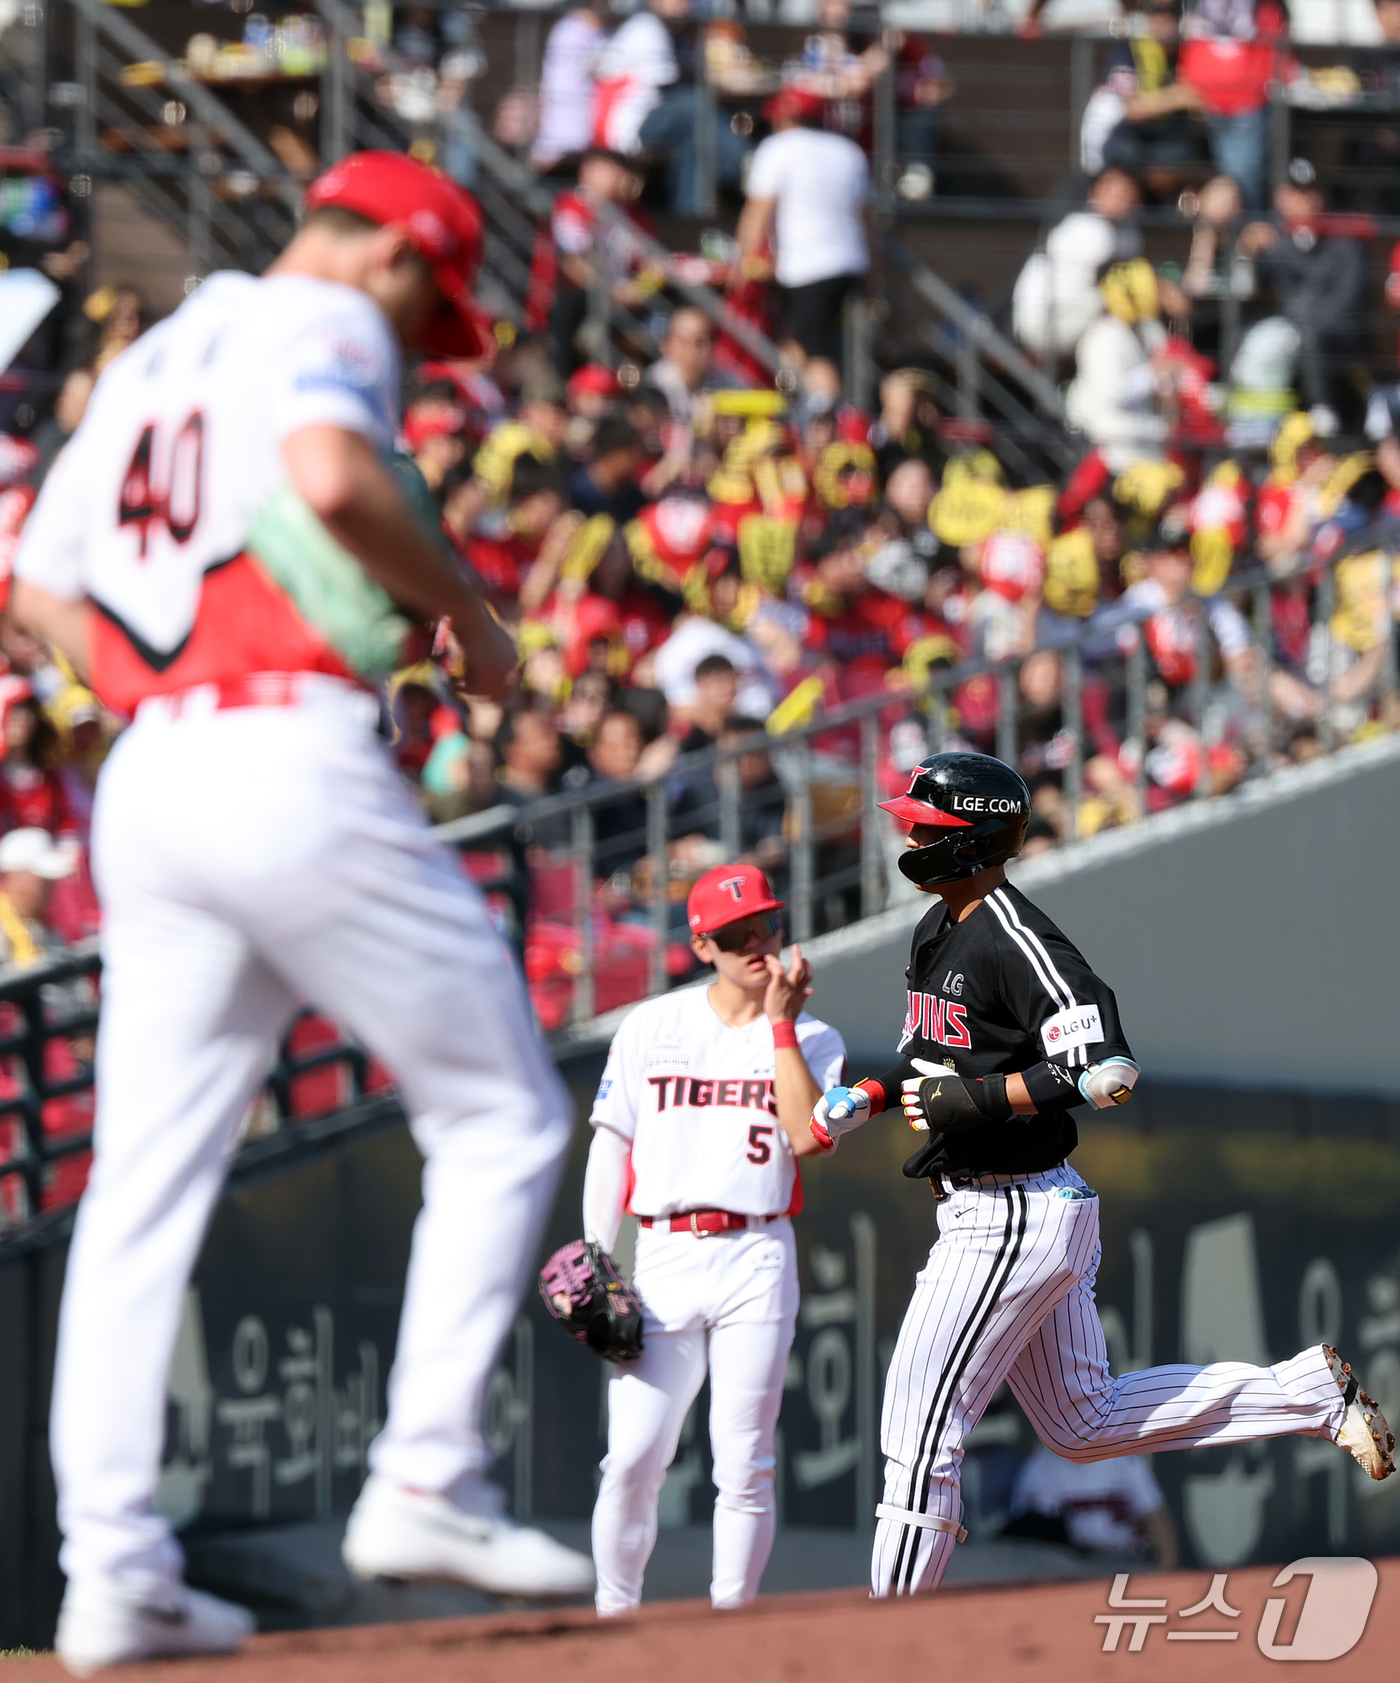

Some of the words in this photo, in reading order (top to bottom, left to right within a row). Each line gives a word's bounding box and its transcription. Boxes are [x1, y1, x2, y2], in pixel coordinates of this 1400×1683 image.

[115, 408, 205, 561] 40
[953, 795, 1022, 814] LGE.COM
[717, 876, 747, 903] T
[941, 970, 965, 997] LG
[1062, 1021, 1080, 1036] LG
[1080, 1015, 1098, 1030] U+
[746, 1124, 774, 1166] 5
